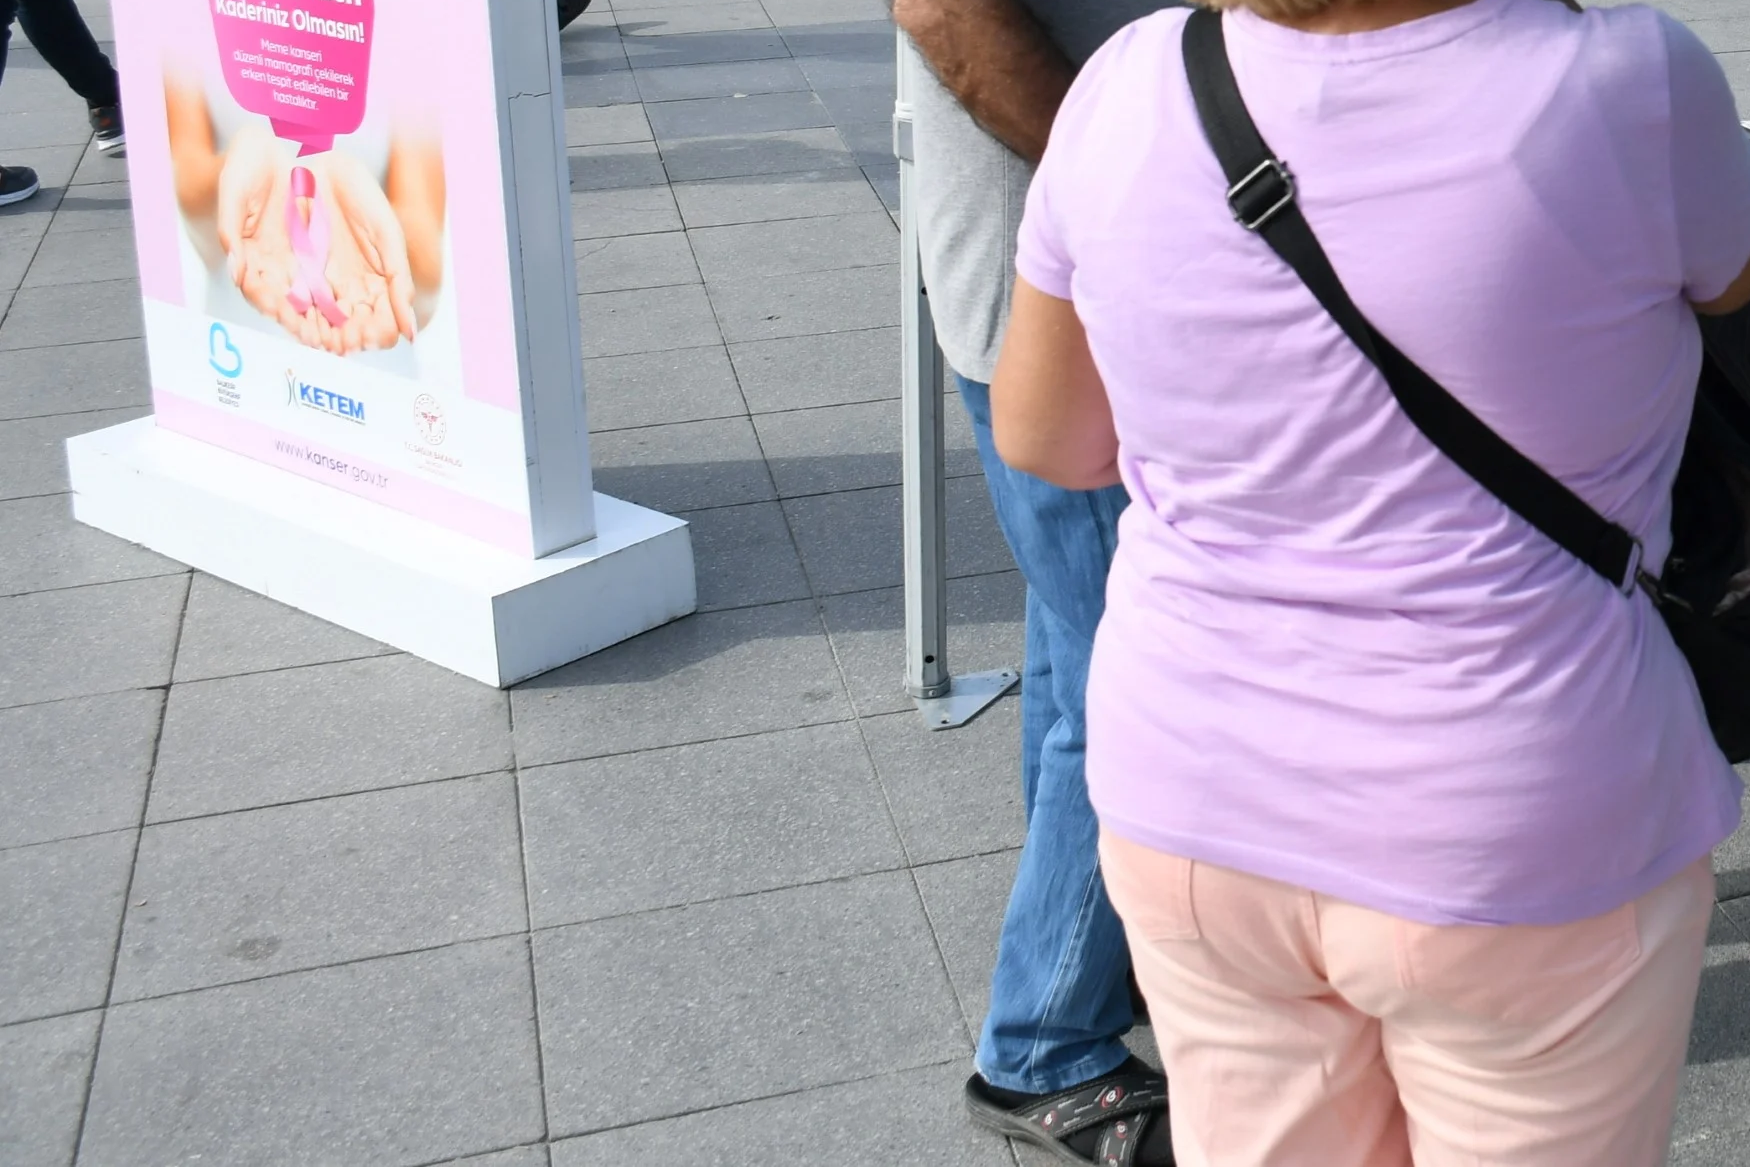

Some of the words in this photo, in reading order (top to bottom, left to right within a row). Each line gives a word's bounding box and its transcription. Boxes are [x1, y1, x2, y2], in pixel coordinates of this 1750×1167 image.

[292, 8, 365, 44] Olmasın!
[260, 38, 289, 55] Meme
[300, 382, 366, 421] KETEM
[274, 437, 389, 489] www.kanser.gov.tr
